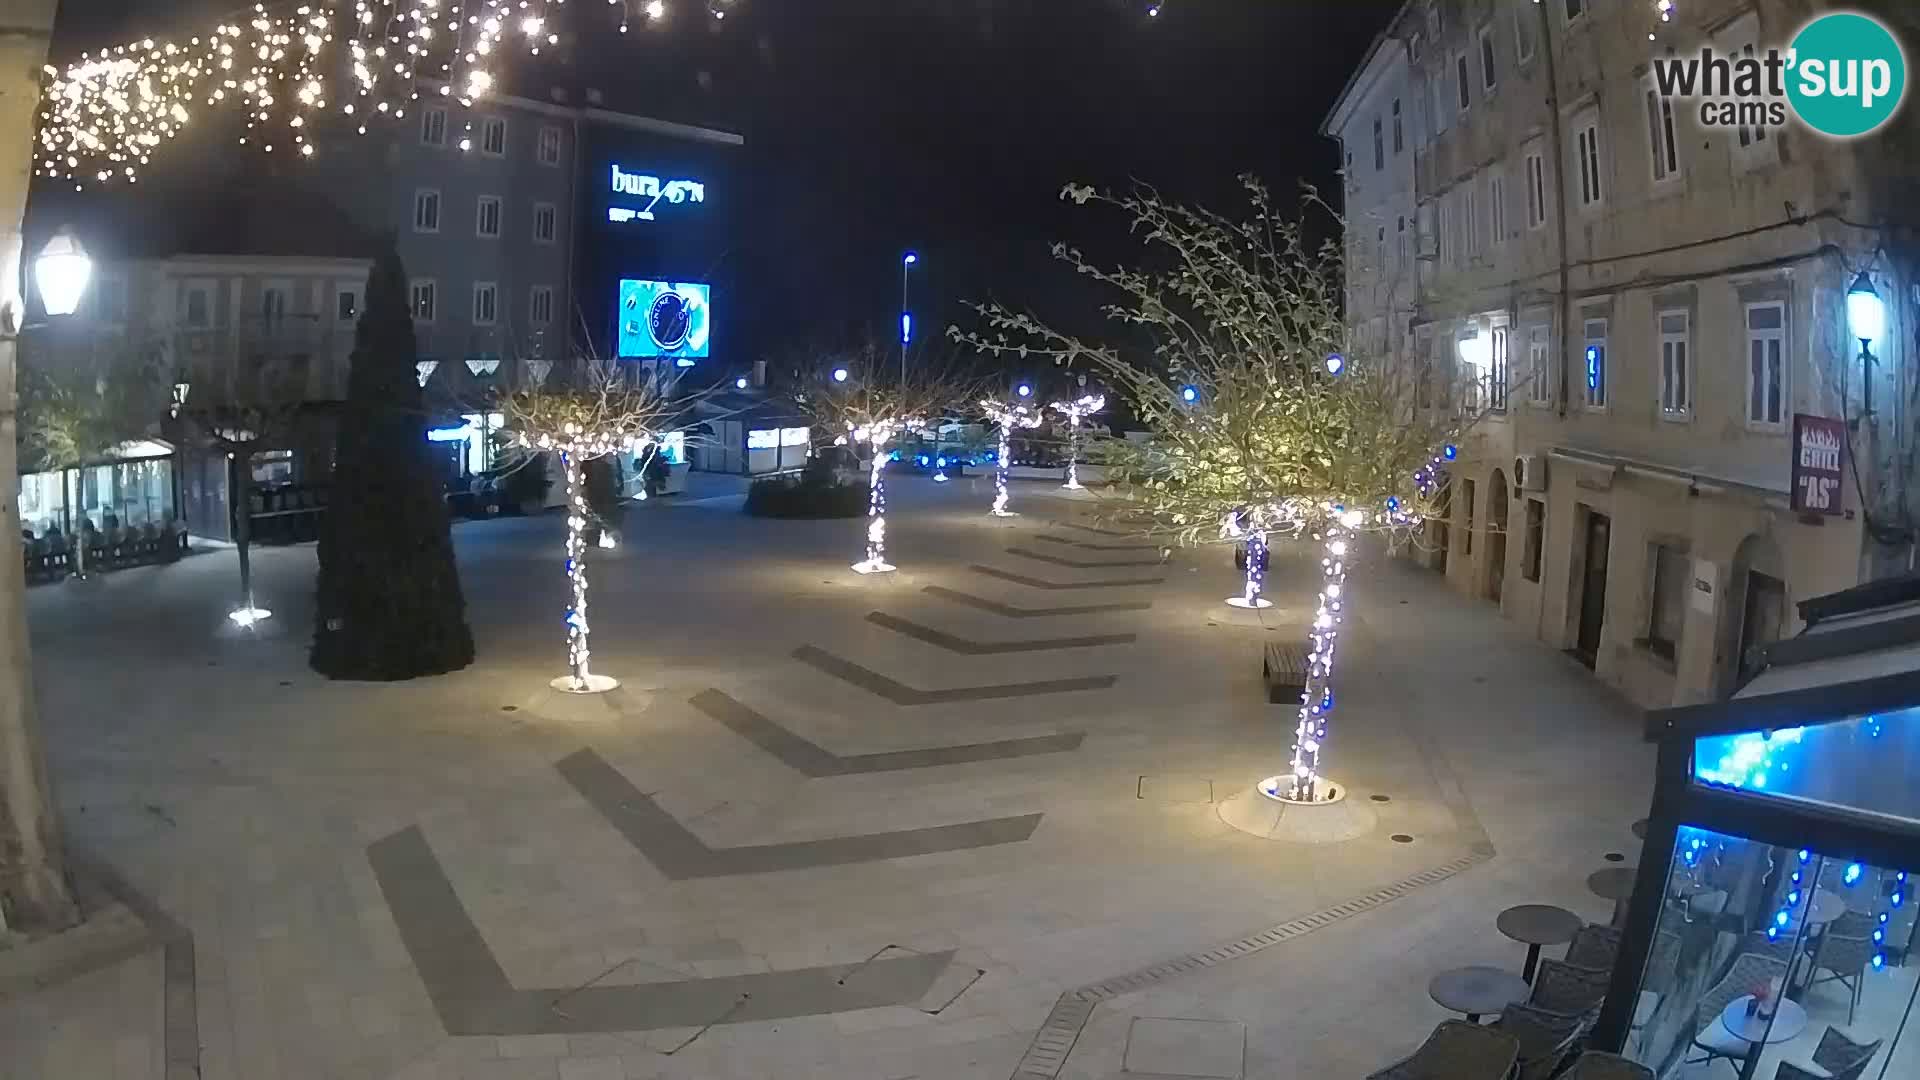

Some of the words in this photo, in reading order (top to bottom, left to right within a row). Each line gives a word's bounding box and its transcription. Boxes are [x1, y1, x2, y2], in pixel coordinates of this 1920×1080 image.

[612, 164, 660, 197] bura
[653, 296, 669, 328] ONLINE
[1800, 447, 1840, 472] GRILL
